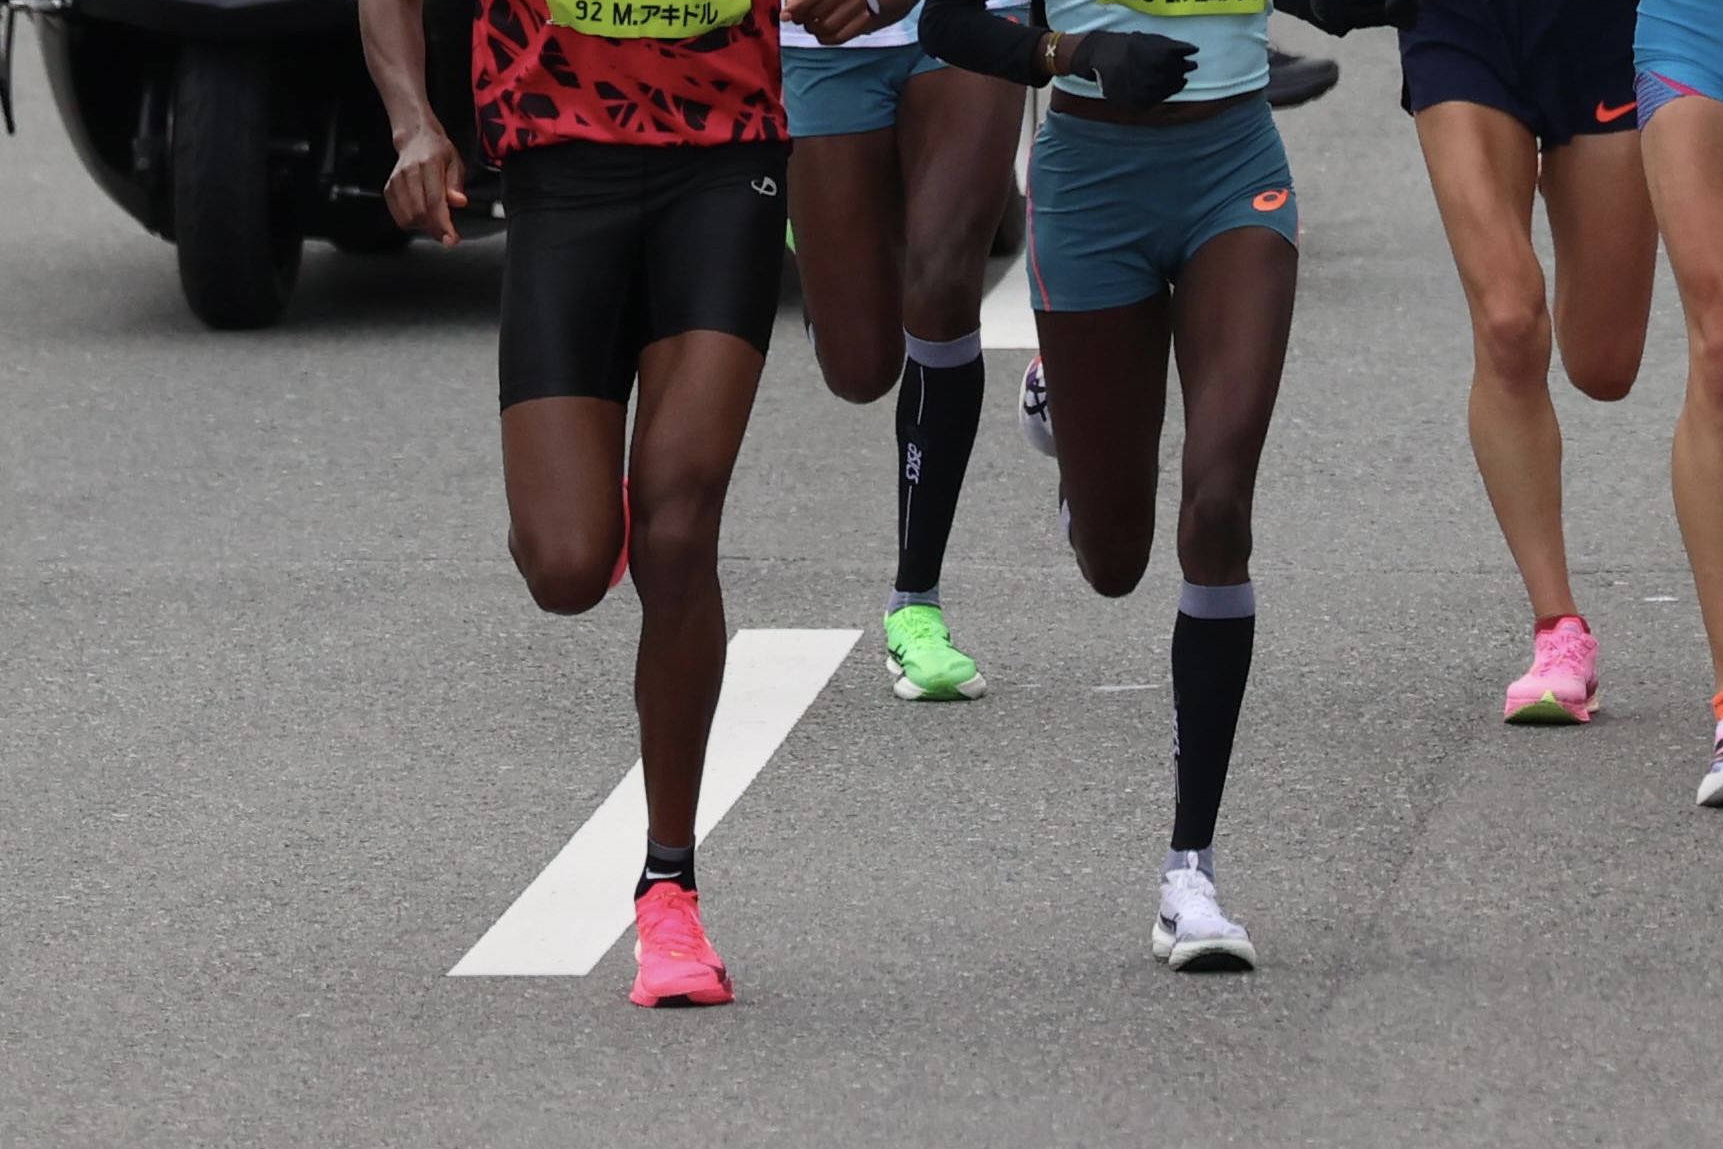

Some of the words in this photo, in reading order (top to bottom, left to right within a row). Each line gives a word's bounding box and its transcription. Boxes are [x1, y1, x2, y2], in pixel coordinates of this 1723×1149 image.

[575, 0, 604, 22] 92
[613, 2, 719, 27] M.アキドル
